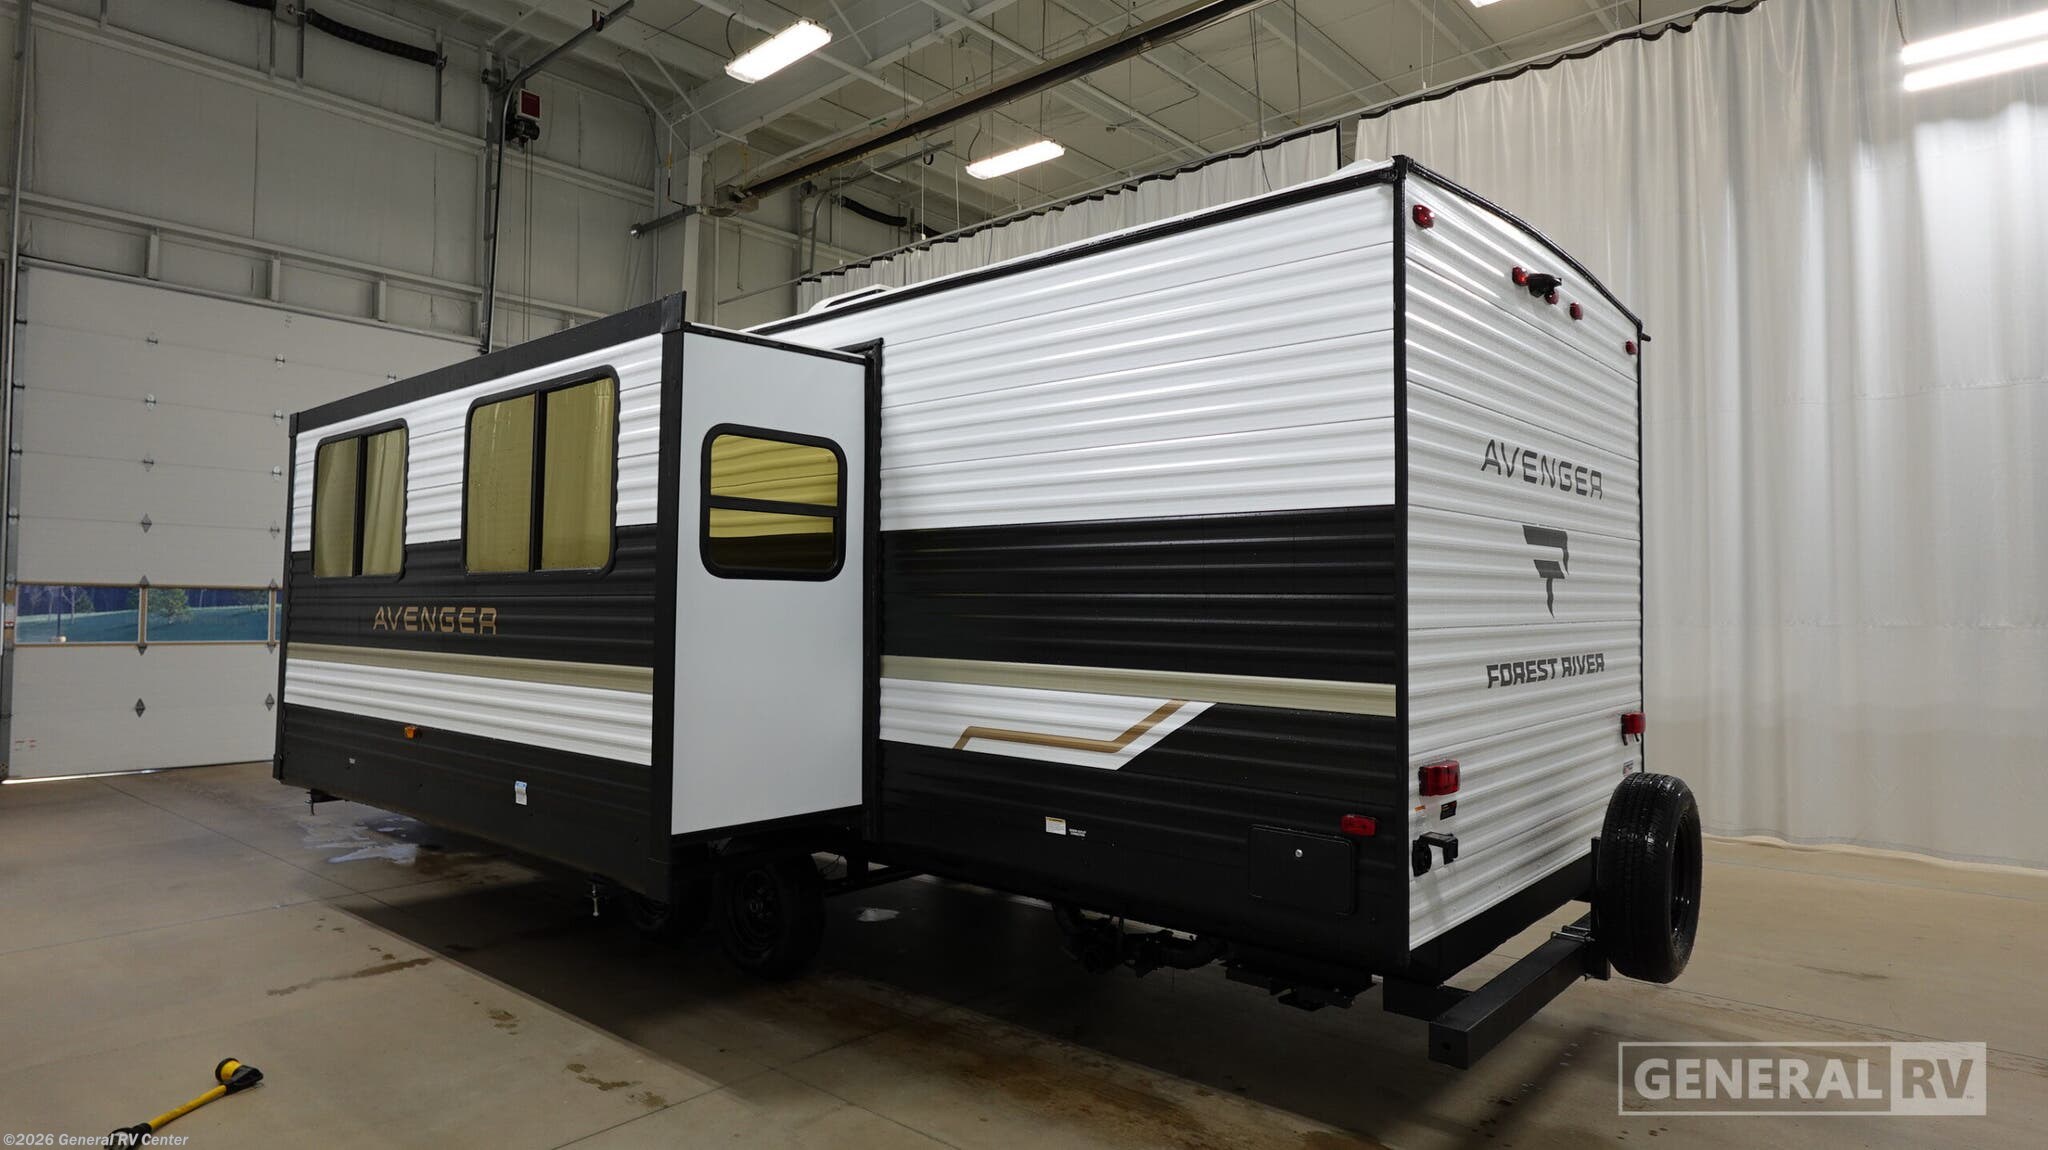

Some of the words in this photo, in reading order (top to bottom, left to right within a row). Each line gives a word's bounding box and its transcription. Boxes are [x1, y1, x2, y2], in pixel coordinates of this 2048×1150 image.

[1480, 438, 1603, 501] AVENGER
[372, 605, 498, 636] AVENGER
[1486, 657, 1557, 689] FOREST
[1561, 653, 1605, 679] RIVER
